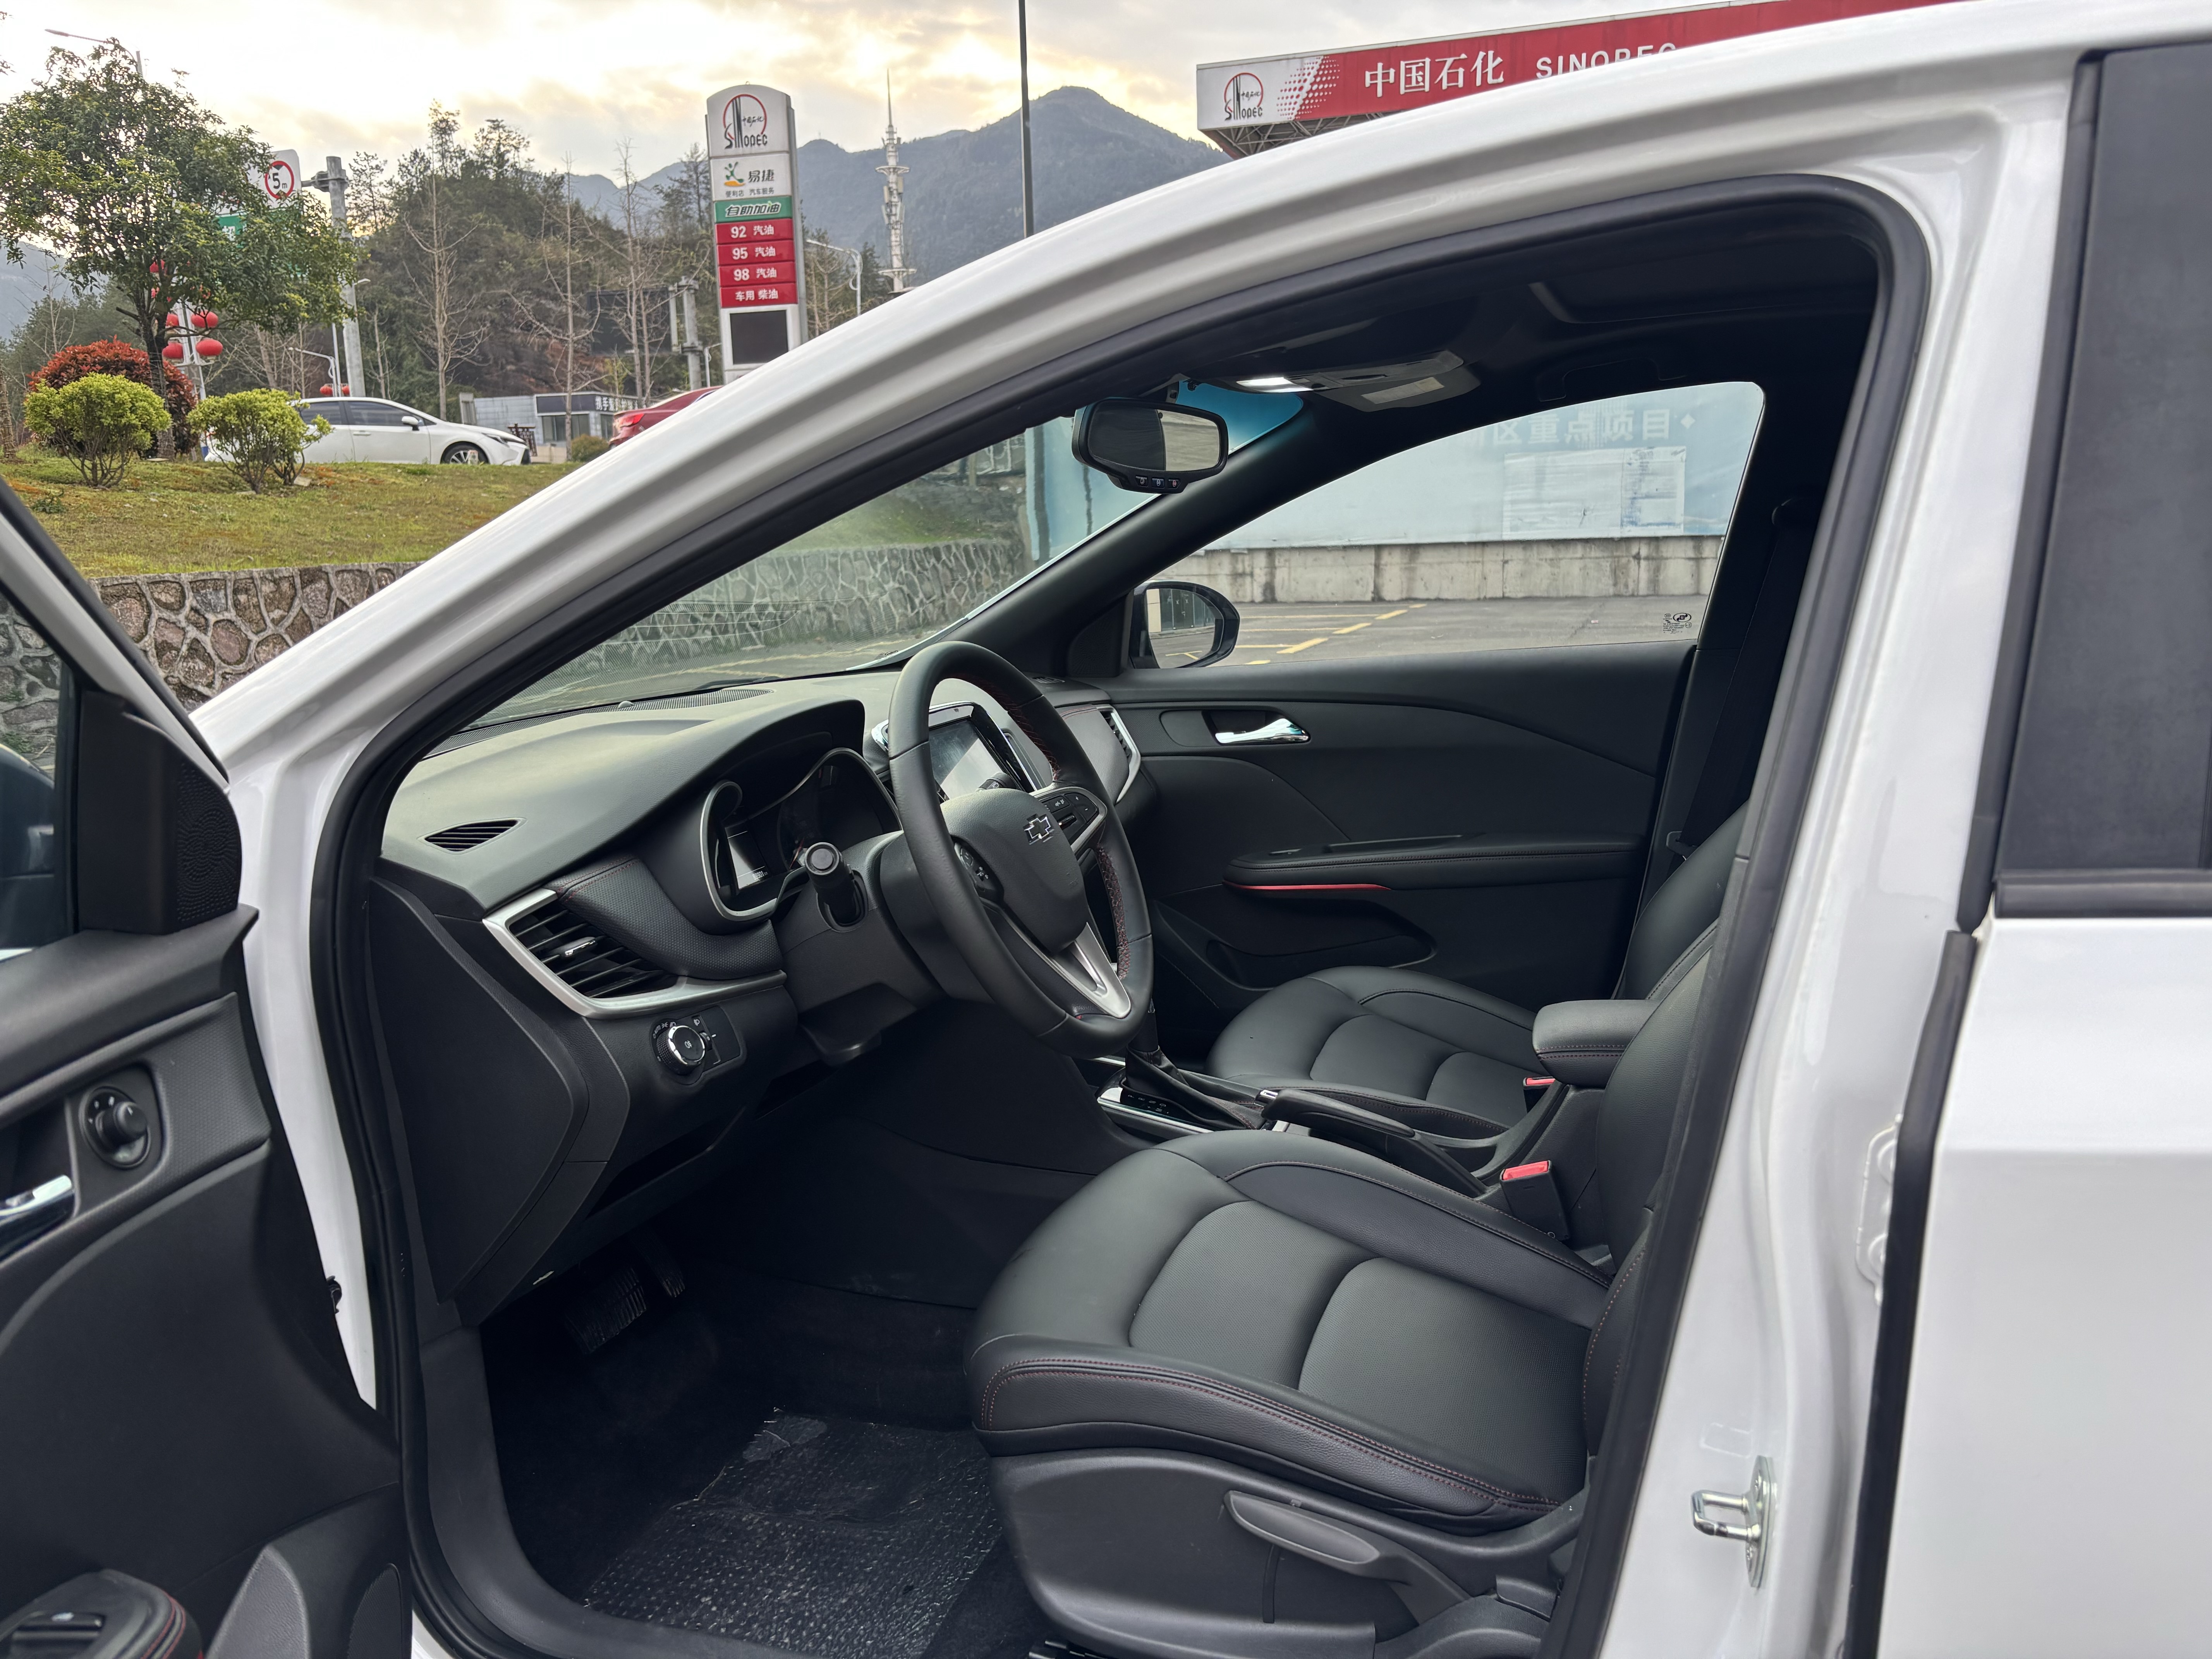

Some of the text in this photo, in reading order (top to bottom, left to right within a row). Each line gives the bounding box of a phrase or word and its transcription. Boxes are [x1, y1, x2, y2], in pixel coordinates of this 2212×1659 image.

[1365, 50, 1504, 98] 中国石化
[748, 169, 775, 182] 易捷
[725, 202, 781, 217] 自助加油
[731, 225, 775, 238] 92 汽油
[732, 246, 776, 260] 95 汽油
[733, 267, 777, 281] 98 汽油
[735, 289, 778, 301] 车用 柴油
